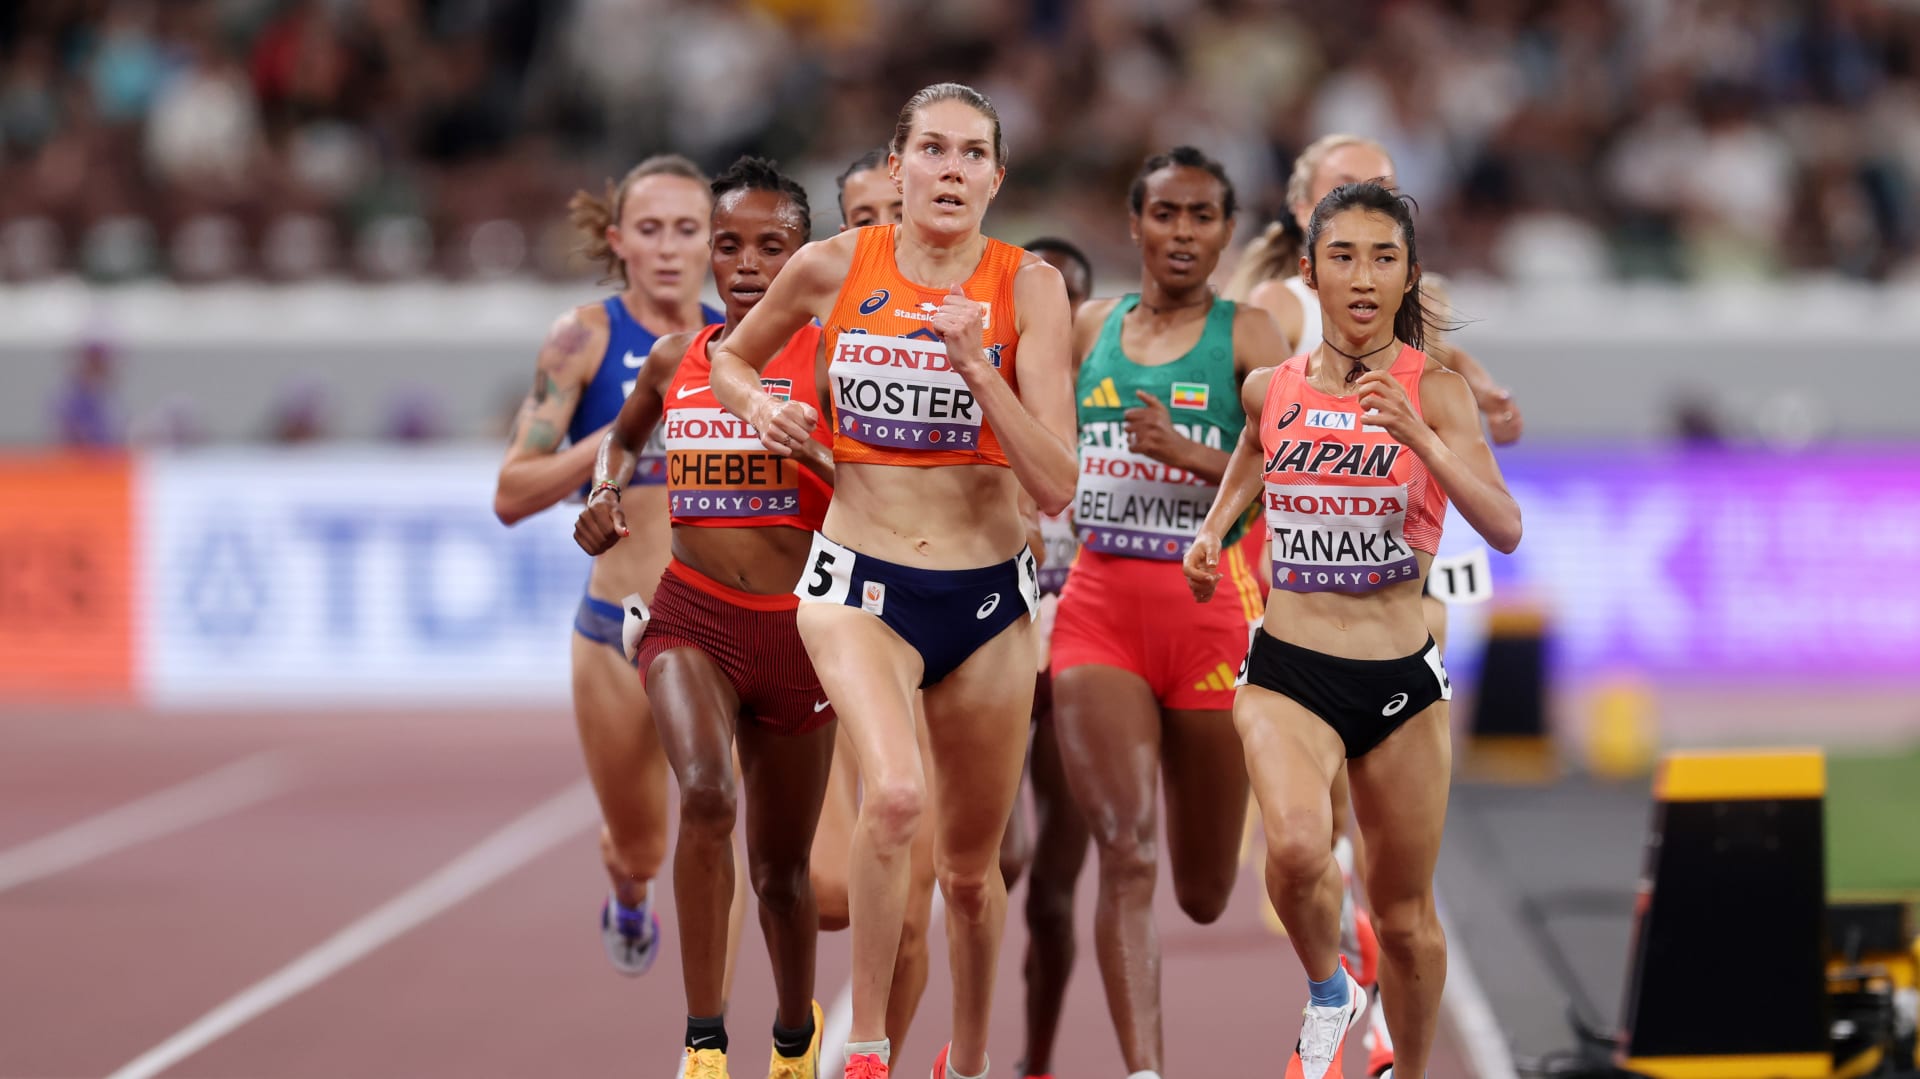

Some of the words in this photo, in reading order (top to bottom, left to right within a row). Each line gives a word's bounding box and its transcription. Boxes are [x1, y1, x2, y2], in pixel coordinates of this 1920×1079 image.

[837, 343, 960, 373] HOND
[838, 376, 976, 421] KOSTER
[666, 419, 760, 440] HOND
[1307, 411, 1355, 429] ACN
[946, 429, 972, 443] 25
[670, 454, 785, 486] CHEBET
[1265, 440, 1401, 479] JAPAN
[768, 496, 794, 510] 25
[1080, 490, 1212, 529] BELAYNEH
[1268, 492, 1404, 516] HONDA
[1274, 527, 1407, 563] TANAKA
[807, 550, 836, 597] 5
[1387, 565, 1412, 580] 25
[1440, 561, 1477, 595] 11
